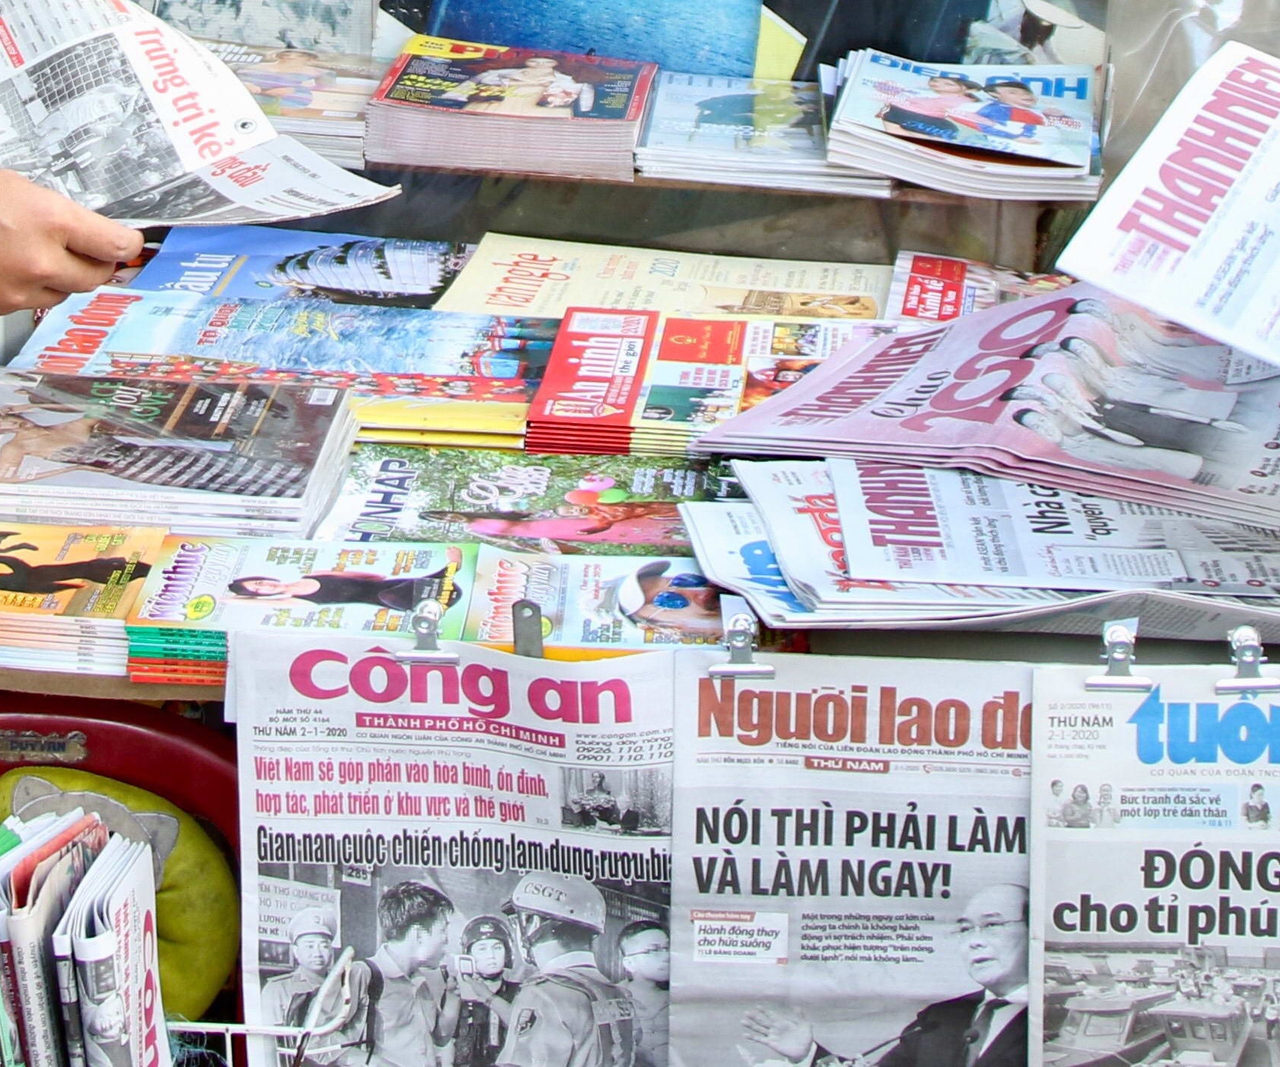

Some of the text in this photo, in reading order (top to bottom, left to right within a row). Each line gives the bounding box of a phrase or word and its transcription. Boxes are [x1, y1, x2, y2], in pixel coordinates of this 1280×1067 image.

[134, 25, 191, 95] Trừng
[918, 276, 945, 291] tế
[568, 336, 625, 379] ninh
[289, 646, 634, 724] Công an
[697, 677, 869, 747] Người
[879, 686, 972, 749] lao
[1082, 715, 1114, 728] NĂM
[361, 716, 561, 747] THÀNH PHỐ CHÍ MINH
[1048, 730, 1100, 741] 2-1-2020
[254, 756, 550, 799] Việt Nam sẽ góp phần vào hòa bình, định,
[811, 757, 844, 771] THỨ
[846, 758, 884, 772] NĂM
[255, 788, 527, 824] hợp tác, phát triển ở khu vực và thế giới
[1120, 792, 1206, 806] Bức tranh sắc
[695, 798, 1027, 854] NÓI THÌ PHẢI LÀM
[257, 825, 647, 886] Gian nan cuộc chiến chống lạm dụng rượu
[523, 881, 568, 902] CSGT
[692, 848, 952, 900] VÀ LÀM NGAY!
[728, 925, 781, 940] động thay
[1052, 894, 1138, 934] cho
[1144, 893, 1179, 934] tỉ
[1188, 895, 1278, 946] phú
[697, 937, 717, 949] cho
